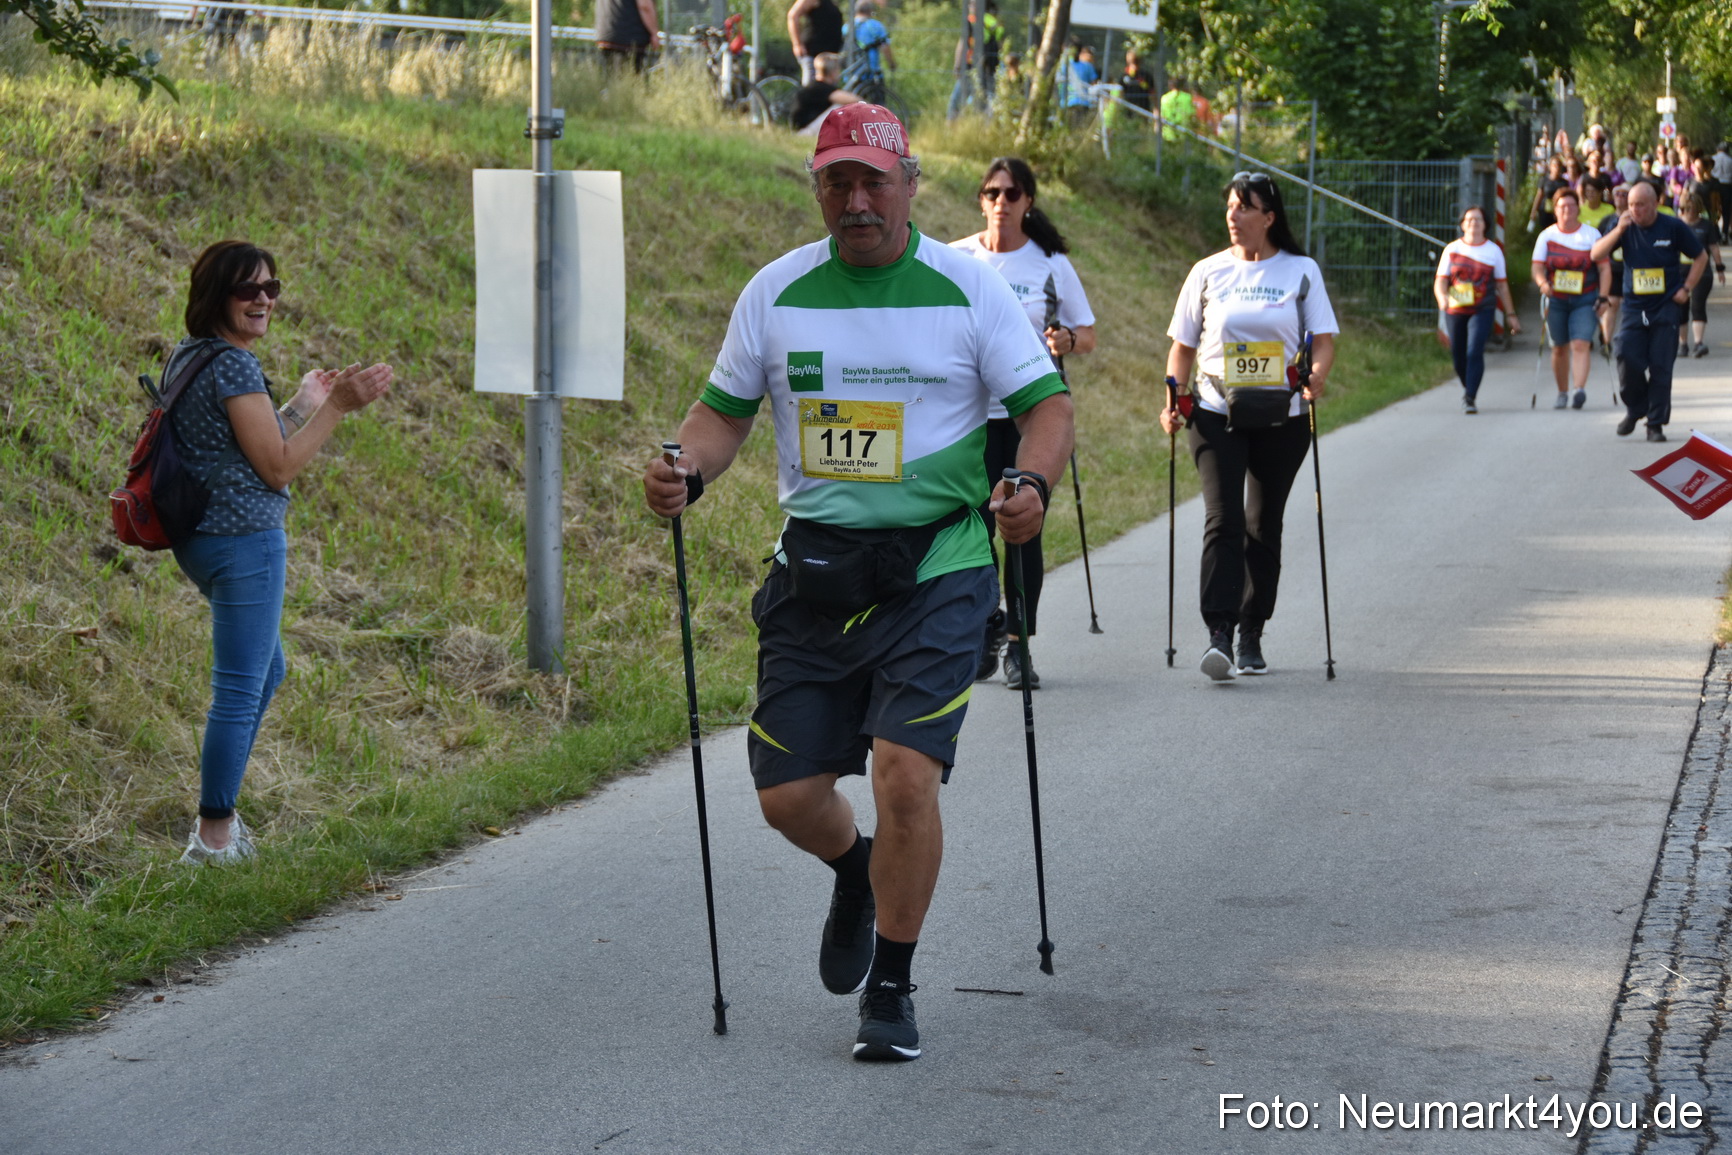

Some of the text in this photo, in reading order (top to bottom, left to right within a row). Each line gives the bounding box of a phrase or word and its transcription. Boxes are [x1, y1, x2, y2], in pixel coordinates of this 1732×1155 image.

[862, 122, 904, 156] FIAT
[1235, 286, 1285, 296] HAUBNER
[1236, 357, 1270, 374] 997
[788, 365, 821, 377] BayWa
[842, 366, 910, 376] BayWa Baustoffe
[842, 376, 948, 385] Immer ein gutes Baugefühl
[813, 414, 853, 424] firmenlauf
[820, 429, 878, 459] 117
[819, 458, 879, 468] Liebhardt Peter
